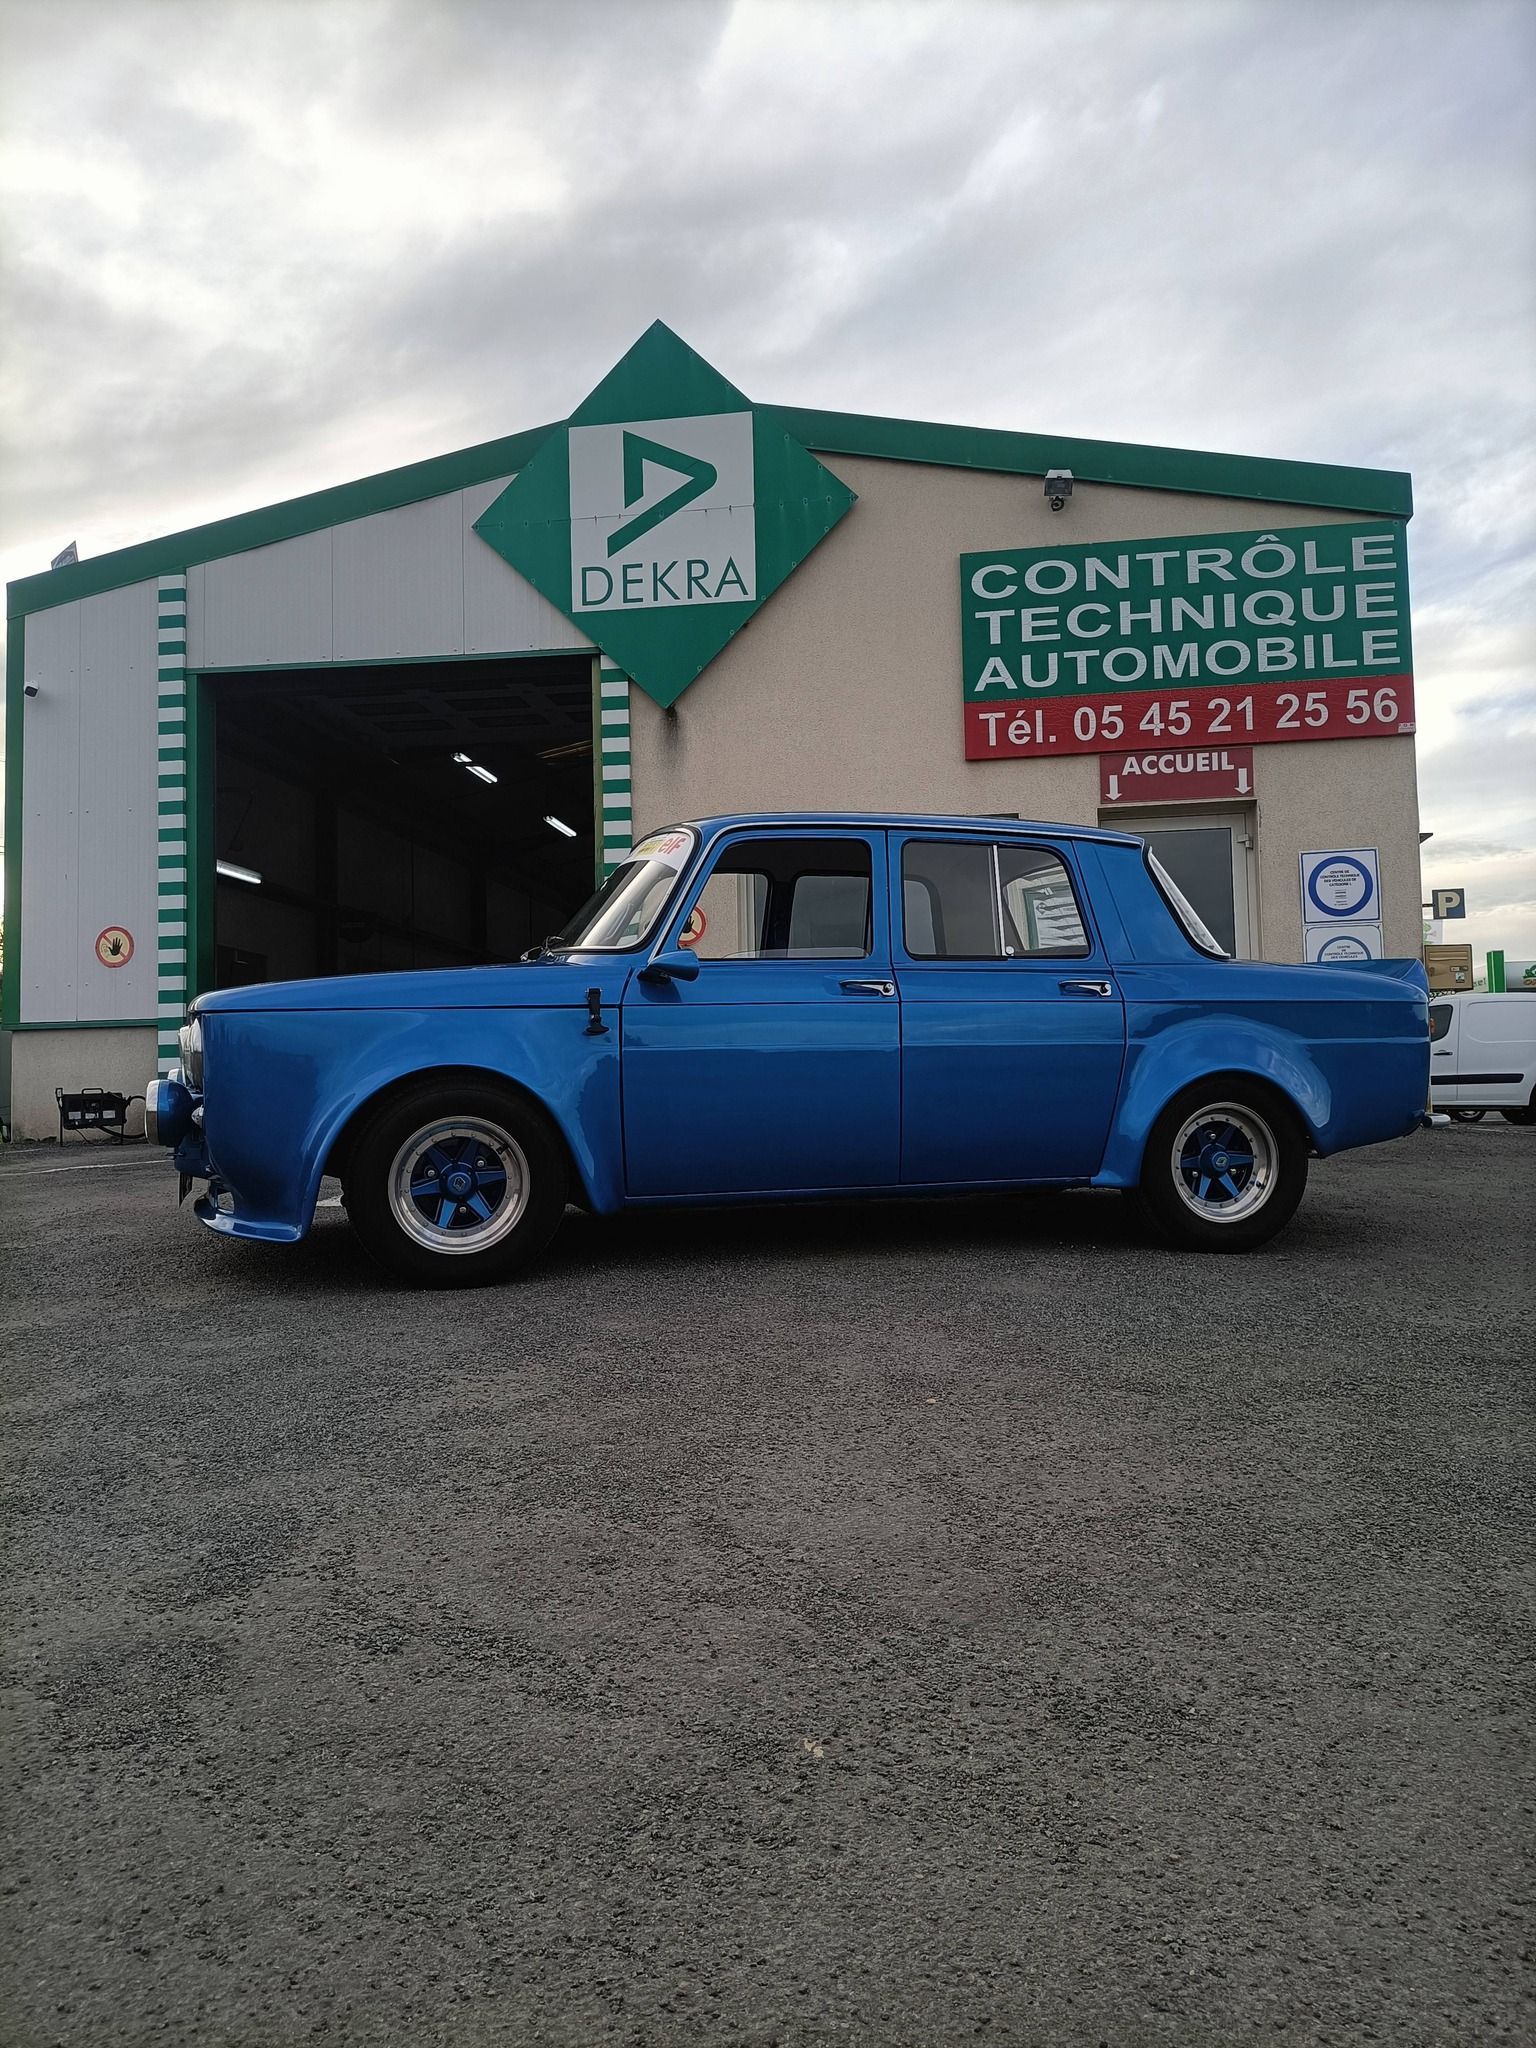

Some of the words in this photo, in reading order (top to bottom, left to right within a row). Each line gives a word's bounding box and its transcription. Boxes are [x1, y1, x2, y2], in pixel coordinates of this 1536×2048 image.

[581, 556, 749, 606] DEKRA
[970, 534, 1397, 599] CONTRÔLE
[974, 582, 1398, 645] TECHNIQUE
[974, 629, 1401, 692] AUTOMOBILE
[978, 709, 1056, 746] Tél.
[1074, 705, 1124, 741] 05
[1139, 700, 1192, 737] 45
[1207, 696, 1254, 733] 21
[1275, 691, 1329, 729] 25
[1346, 688, 1399, 724] 56
[1121, 751, 1235, 776] ACCUEIL
[1438, 891, 1461, 917] P
